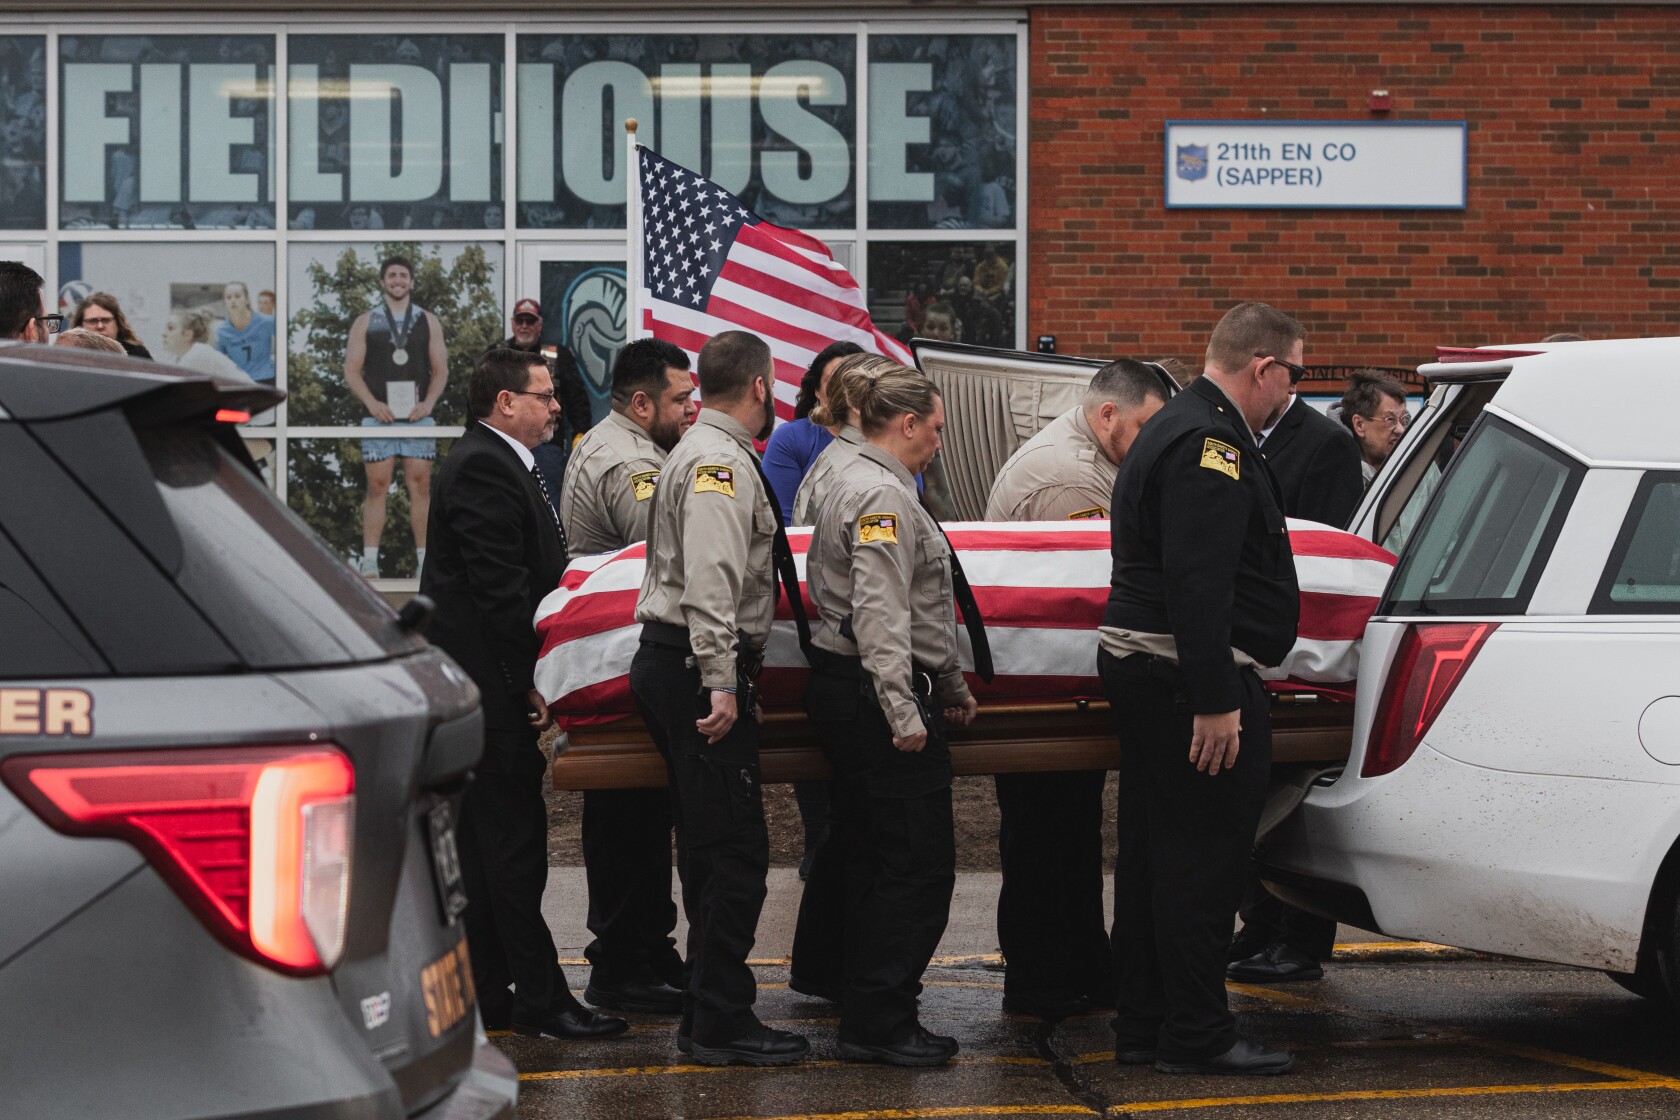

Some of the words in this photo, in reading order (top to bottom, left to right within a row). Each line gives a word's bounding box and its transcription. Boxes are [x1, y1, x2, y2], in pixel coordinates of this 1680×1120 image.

[64, 60, 934, 205] FIELDHOUSE
[1217, 142, 1271, 161] 211th
[1281, 143, 1312, 161] EN
[1322, 142, 1356, 161] CO
[1216, 166, 1322, 188] (SAPPER)
[0, 689, 94, 737] ER
